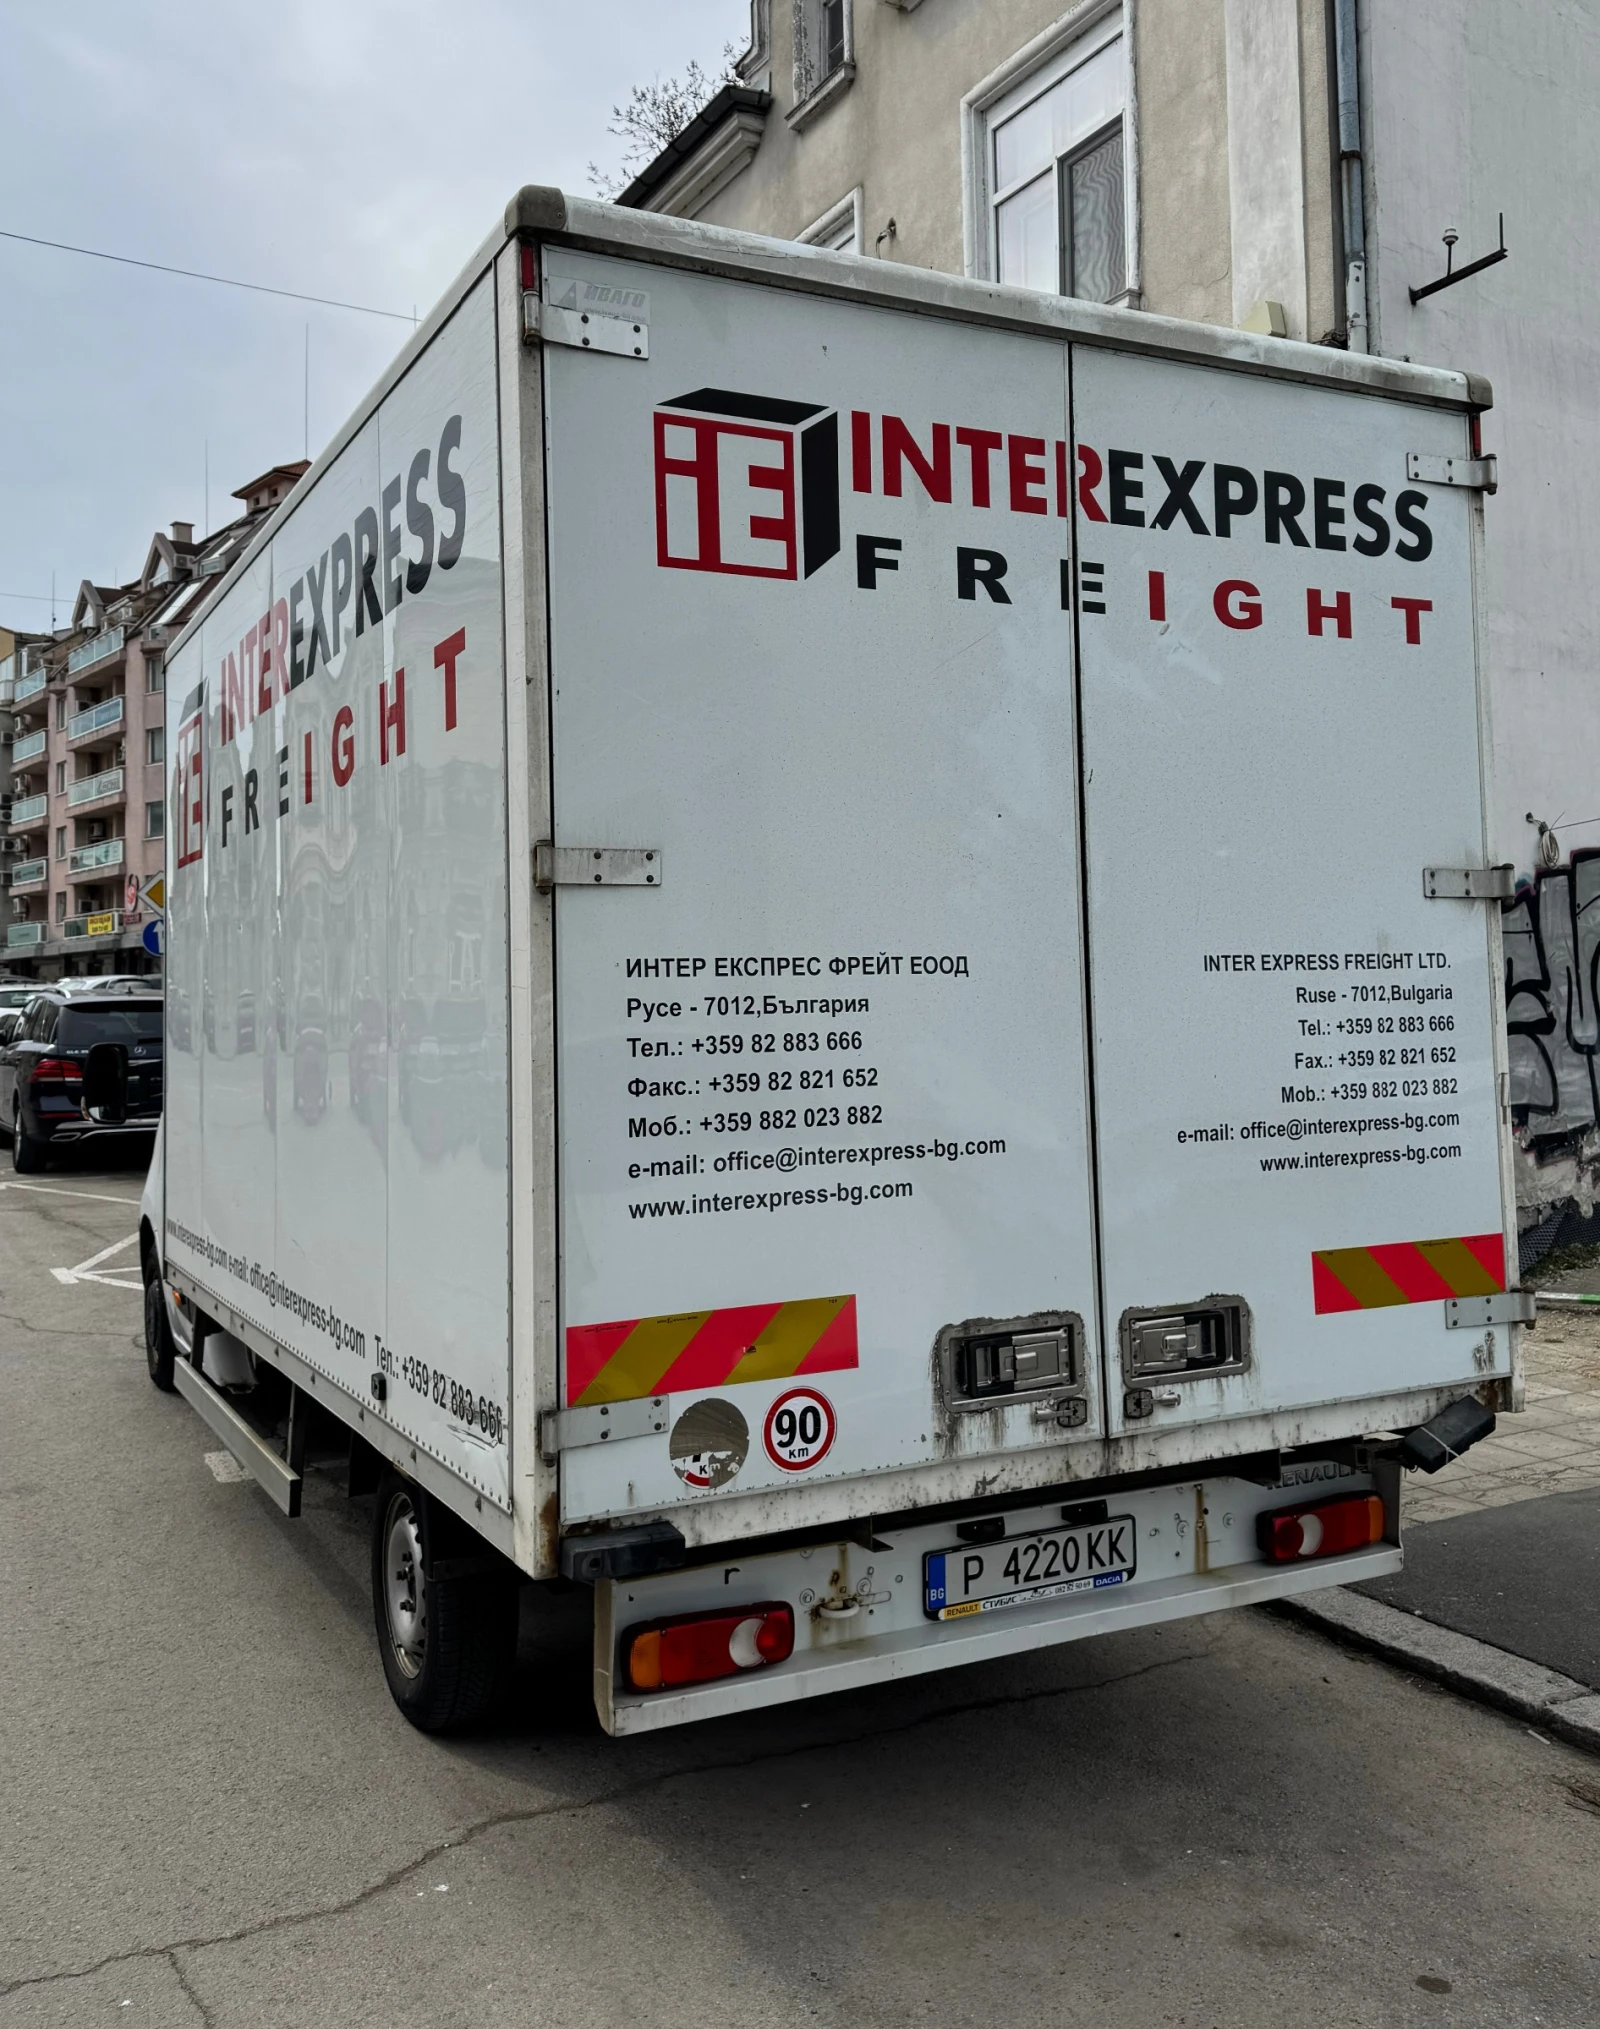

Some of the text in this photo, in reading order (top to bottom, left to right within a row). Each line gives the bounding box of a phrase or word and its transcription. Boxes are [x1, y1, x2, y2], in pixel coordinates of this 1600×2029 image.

[851, 410, 1433, 562] INTEREXPRESS
[220, 414, 466, 748] INTEREXPRESS
[626, 952, 969, 977] ИНТЕР ЕКСПРЕС ФРЕЙТ ЕООД
[1204, 953, 1451, 972] INTER EXPRESS FREIGHT LTD.
[627, 998, 681, 1022] Русе
[704, 996, 869, 1018] 7012,България
[1296, 987, 1336, 1003] Ruse
[1351, 984, 1452, 1004] 7012,Bulgaria
[1298, 1015, 1454, 1036] Tel.: +359 82 883 666
[627, 1031, 862, 1057] Тел.: +359 82 883 666
[1295, 1047, 1456, 1069] Fax.: +359 82 821 652
[628, 1067, 879, 1097] Факс.: +359 82 821 652
[1282, 1078, 1458, 1103] Mob.: +359 882 023 882
[629, 1105, 882, 1138] Моб.: +359 882 023 882
[1178, 1111, 1460, 1143] e-mail: office@interexpress-bg.com
[628, 1136, 1006, 1178] e-mail: office@interexpress-bg.com
[1260, 1142, 1462, 1172] www.interexpress-bg.com
[629, 1181, 913, 1219] www.interexpress-bg.com
[402, 1354, 429, 1397] +359
[432, 1369, 447, 1409] 82
[450, 1379, 475, 1425] 883
[775, 1405, 821, 1448] 90
[930, 1587, 944, 1601] BG
[964, 1555, 984, 1595] P
[946, 1603, 979, 1617] RENAULT
